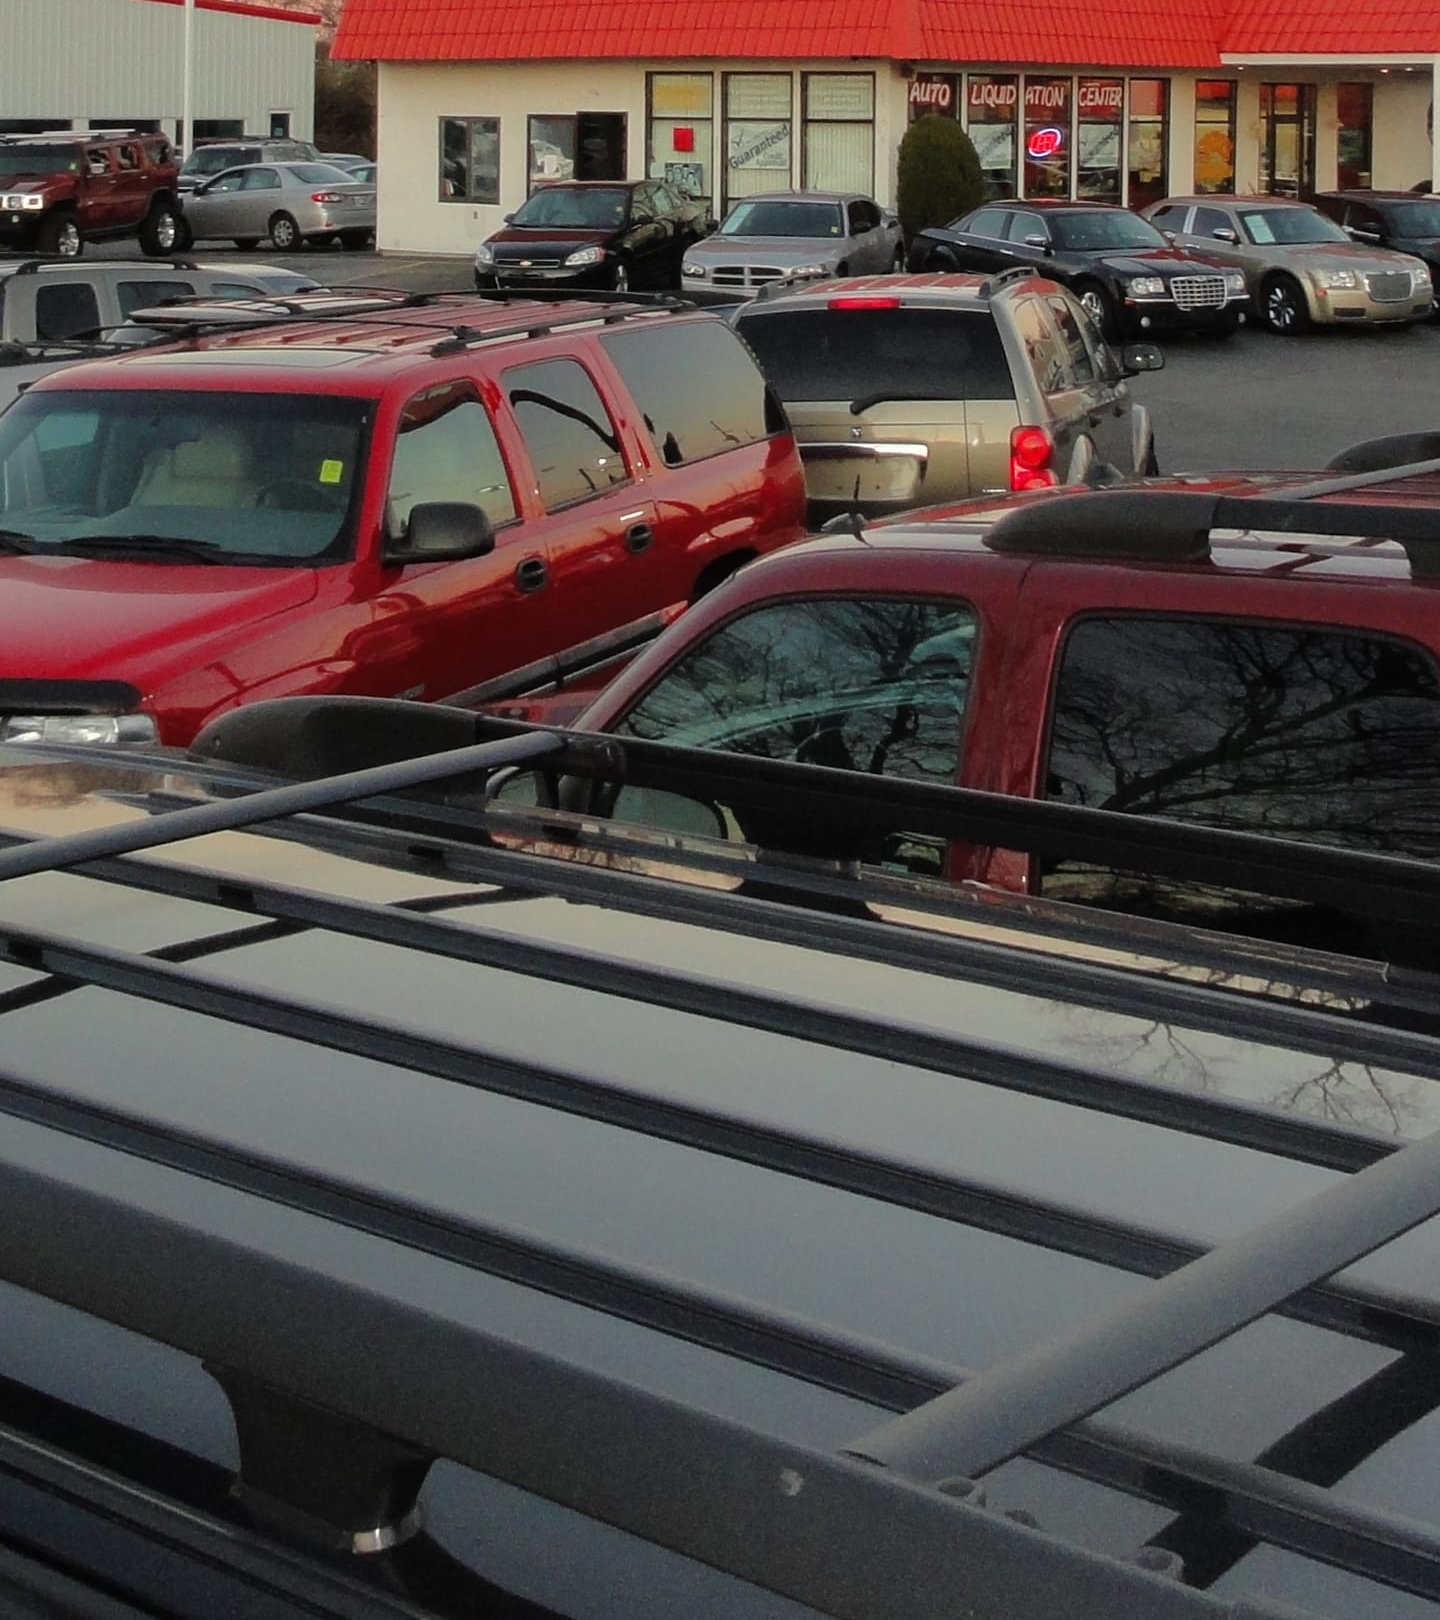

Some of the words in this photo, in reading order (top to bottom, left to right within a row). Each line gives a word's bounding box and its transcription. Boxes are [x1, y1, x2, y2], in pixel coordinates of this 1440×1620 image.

[910, 82, 951, 106] AUTO
[1078, 86, 1123, 107] CENTER
[729, 123, 790, 169] Guaranteed
